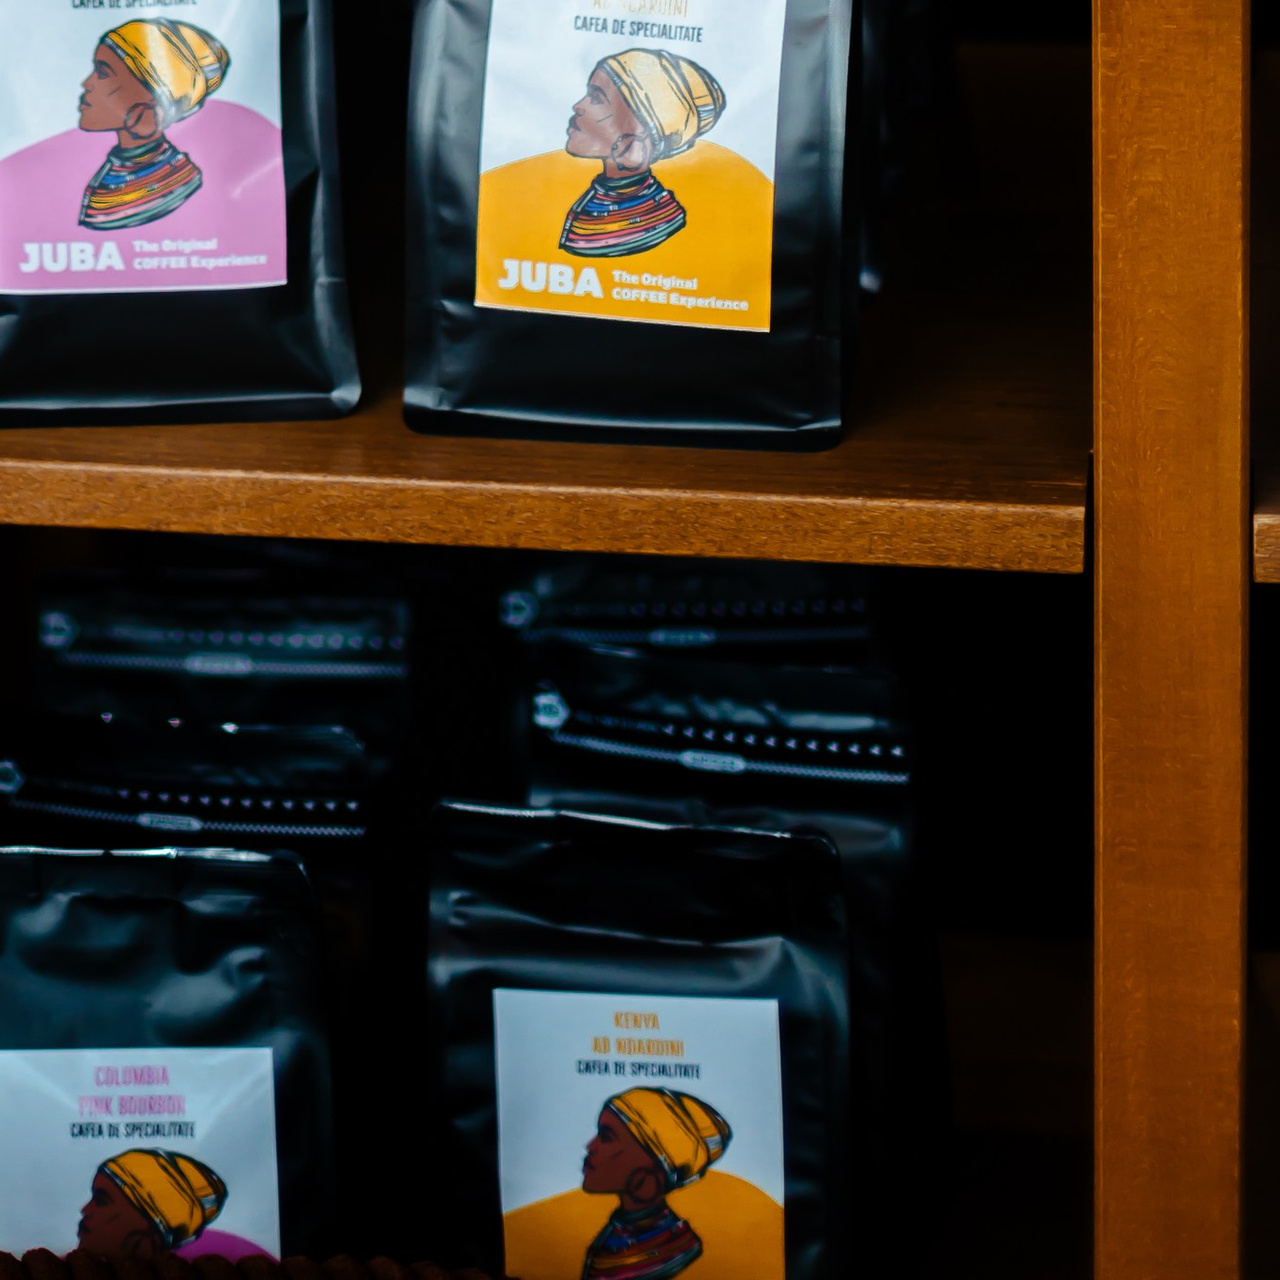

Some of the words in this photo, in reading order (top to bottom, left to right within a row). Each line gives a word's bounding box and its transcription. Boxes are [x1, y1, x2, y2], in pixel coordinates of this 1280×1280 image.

[573, 14, 608, 34] CAFEA
[611, 18, 626, 36] DE
[628, 20, 704, 43] SPECIALITATE
[19, 240, 125, 273] JUBA
[132, 239, 158, 252] The
[161, 238, 219, 253] Original
[132, 256, 188, 270] COFFEE
[190, 254, 268, 270] Experience
[498, 258, 605, 298] JUBA
[611, 269, 638, 284] The
[641, 271, 699, 291] Original
[611, 287, 668, 305] COFFEE
[669, 291, 750, 312] Experience
